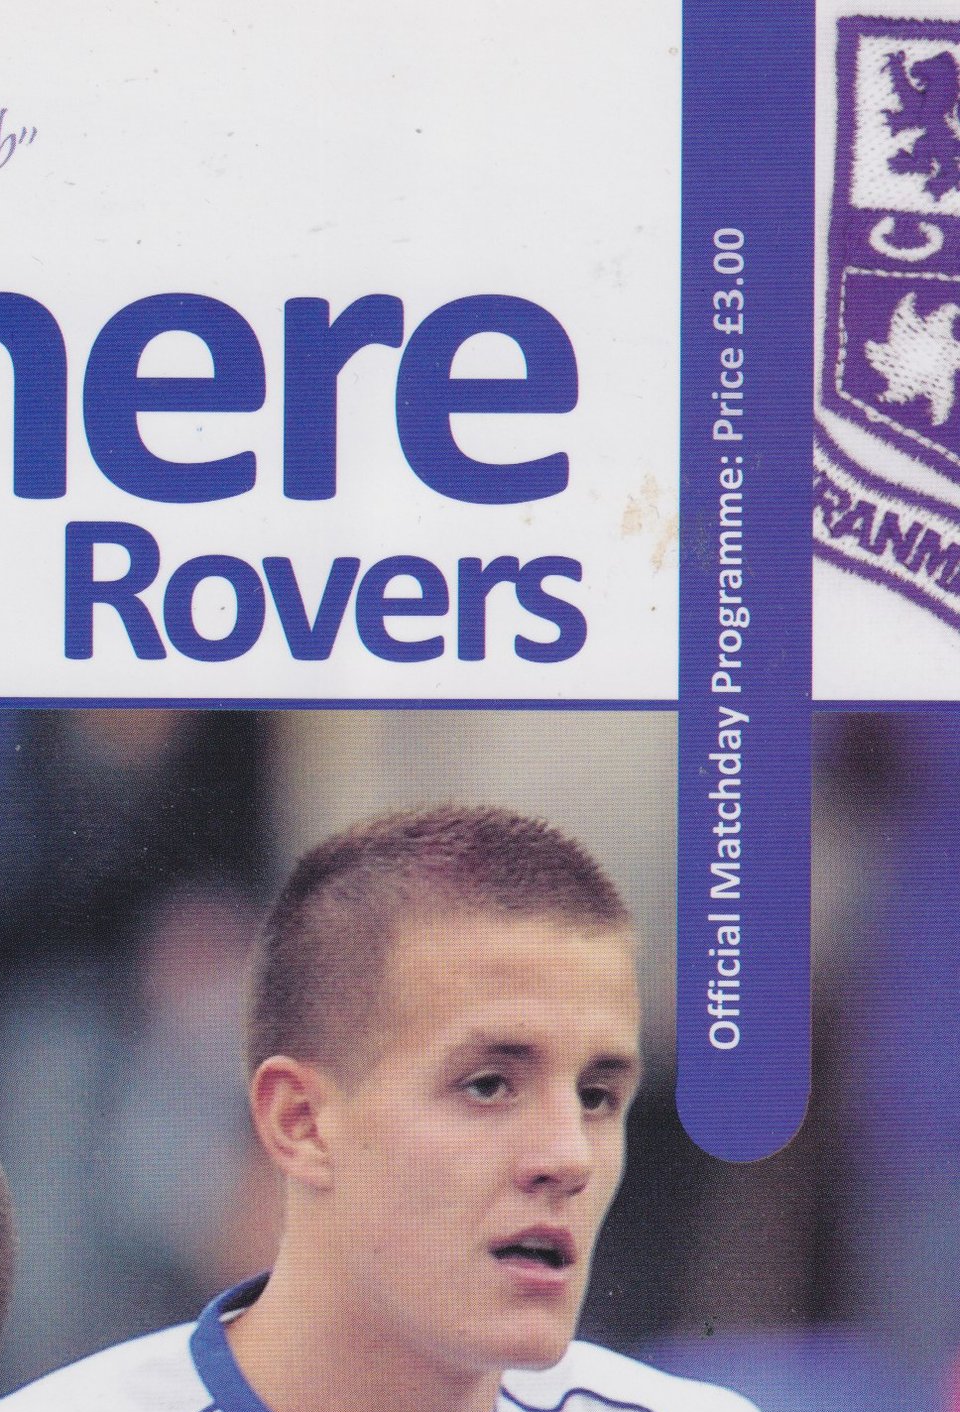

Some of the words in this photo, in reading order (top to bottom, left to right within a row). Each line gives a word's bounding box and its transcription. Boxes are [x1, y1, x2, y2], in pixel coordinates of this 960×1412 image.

[713, 227, 745, 336] £3.00
[713, 346, 745, 441] Price
[64, 520, 588, 663] Rovers
[712, 454, 750, 692] Programme:
[709, 706, 750, 899] Matchday
[708, 914, 741, 1050] Official
